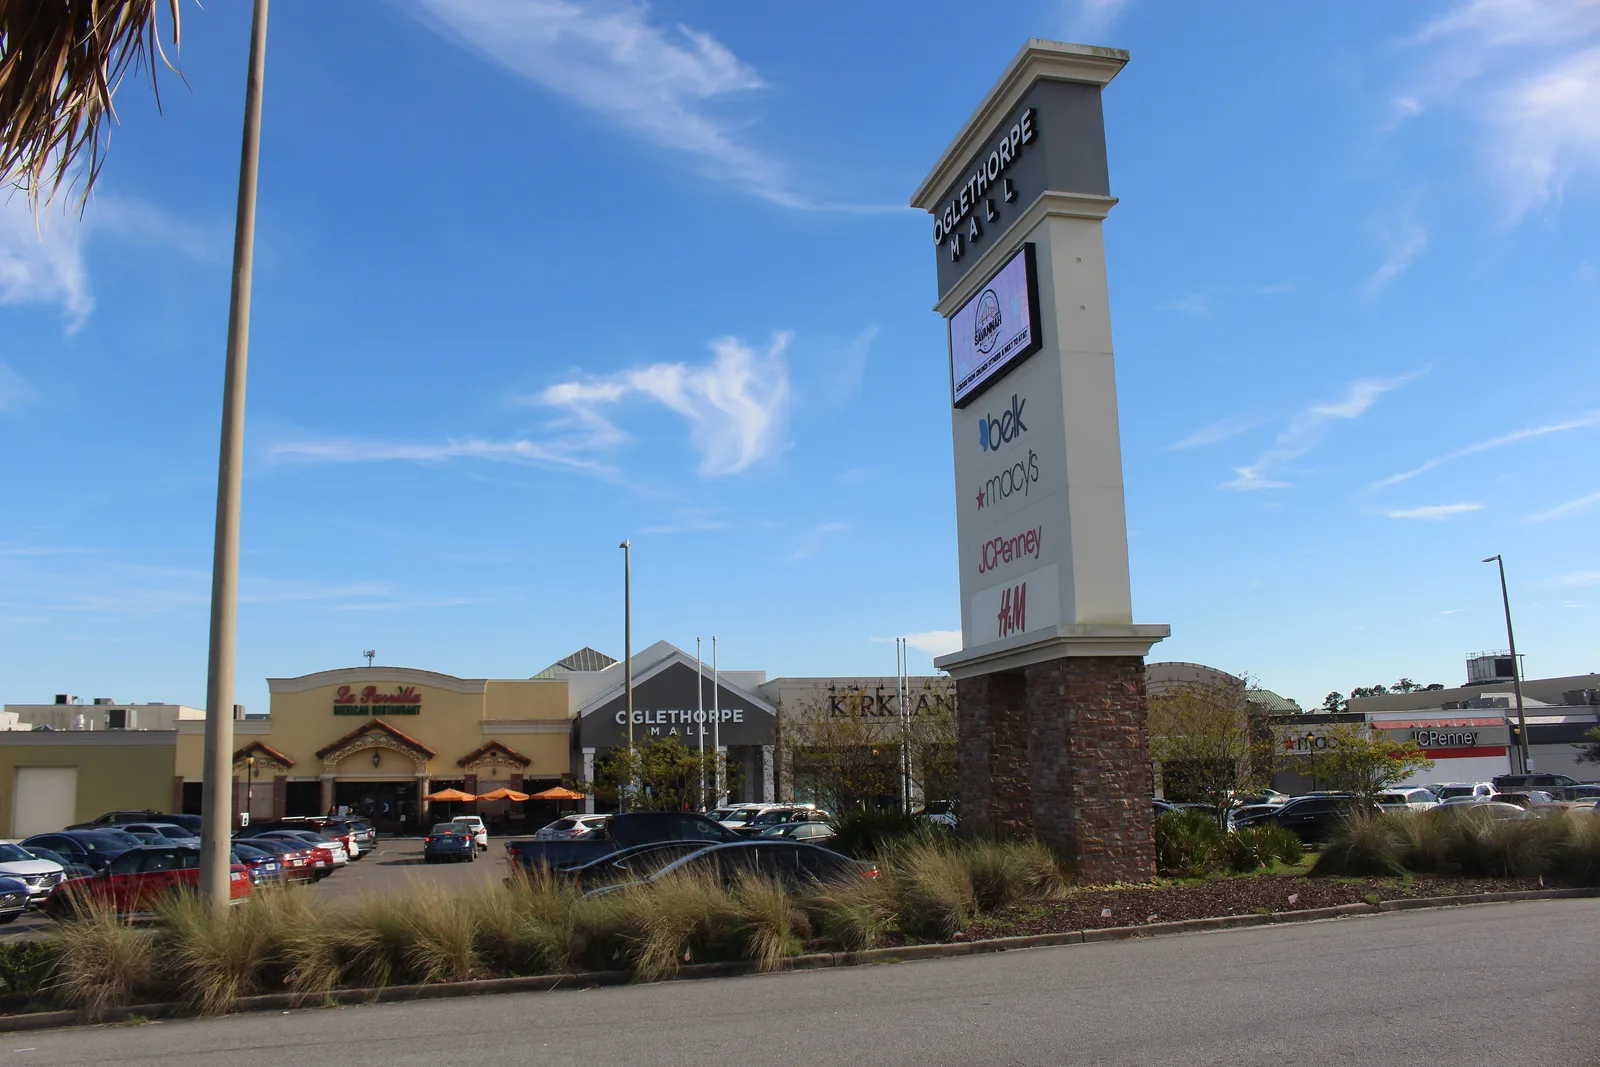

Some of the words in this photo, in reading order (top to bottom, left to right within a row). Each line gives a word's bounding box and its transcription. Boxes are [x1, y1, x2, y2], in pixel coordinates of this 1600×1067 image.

[933, 108, 1035, 246] OGLETHORPE
[951, 178, 1015, 262] MALL
[975, 314, 1001, 346] SAVANNAH
[988, 393, 1028, 451] belk
[985, 449, 1039, 508] macy's
[979, 525, 1042, 574] JCPenney
[997, 581, 1026, 637] H&M
[334, 685, 356, 704] La
[360, 685, 422, 704] Parrilla
[372, 705, 421, 716] RESTAURANT
[615, 709, 744, 725] OGLETHORPE
[651, 726, 709, 736] MALL
[1413, 730, 1480, 747] JCPenney
